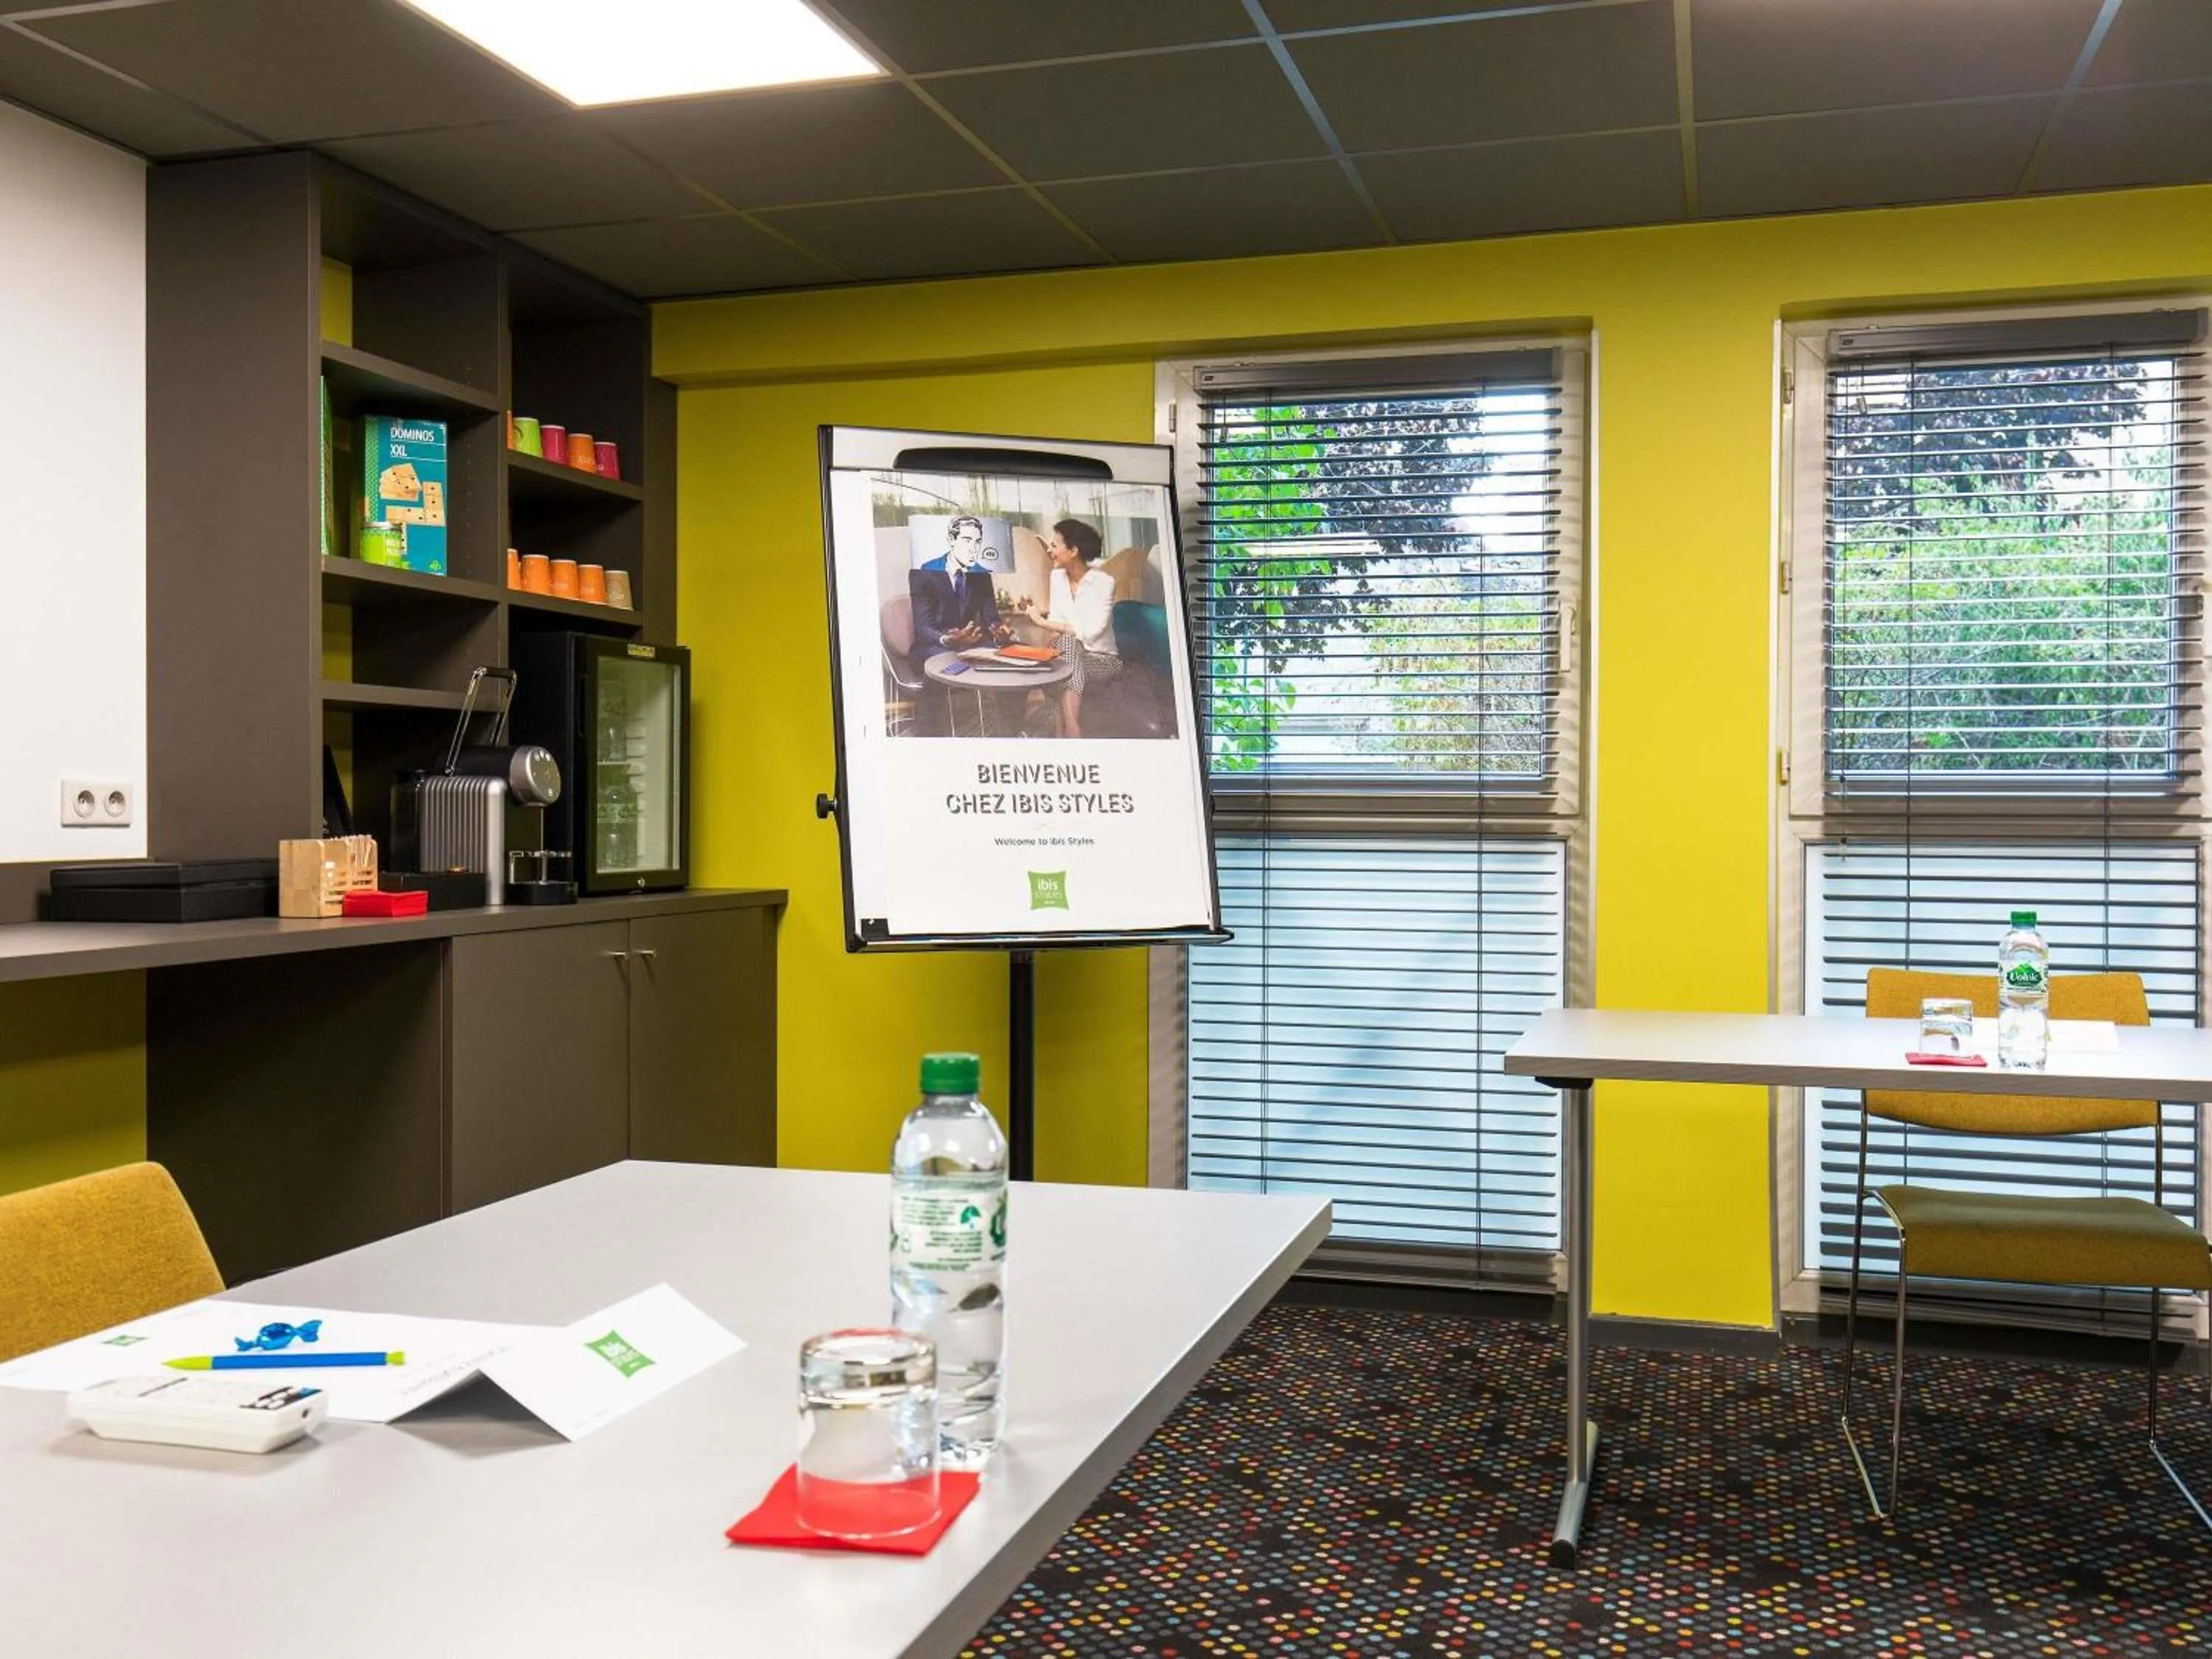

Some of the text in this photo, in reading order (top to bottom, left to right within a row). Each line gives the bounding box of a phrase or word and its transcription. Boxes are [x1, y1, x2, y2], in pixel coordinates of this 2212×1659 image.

[390, 427, 435, 442] DOMINOS
[390, 443, 408, 456] XXL
[977, 764, 1101, 784] BIENVENUE
[946, 793, 1135, 814] CHEZ IBIS STYLES
[994, 838, 1036, 846] Welcome
[1037, 837, 1048, 846] to
[1067, 837, 1095, 847] Styles
[1037, 878, 1058, 891] ibis
